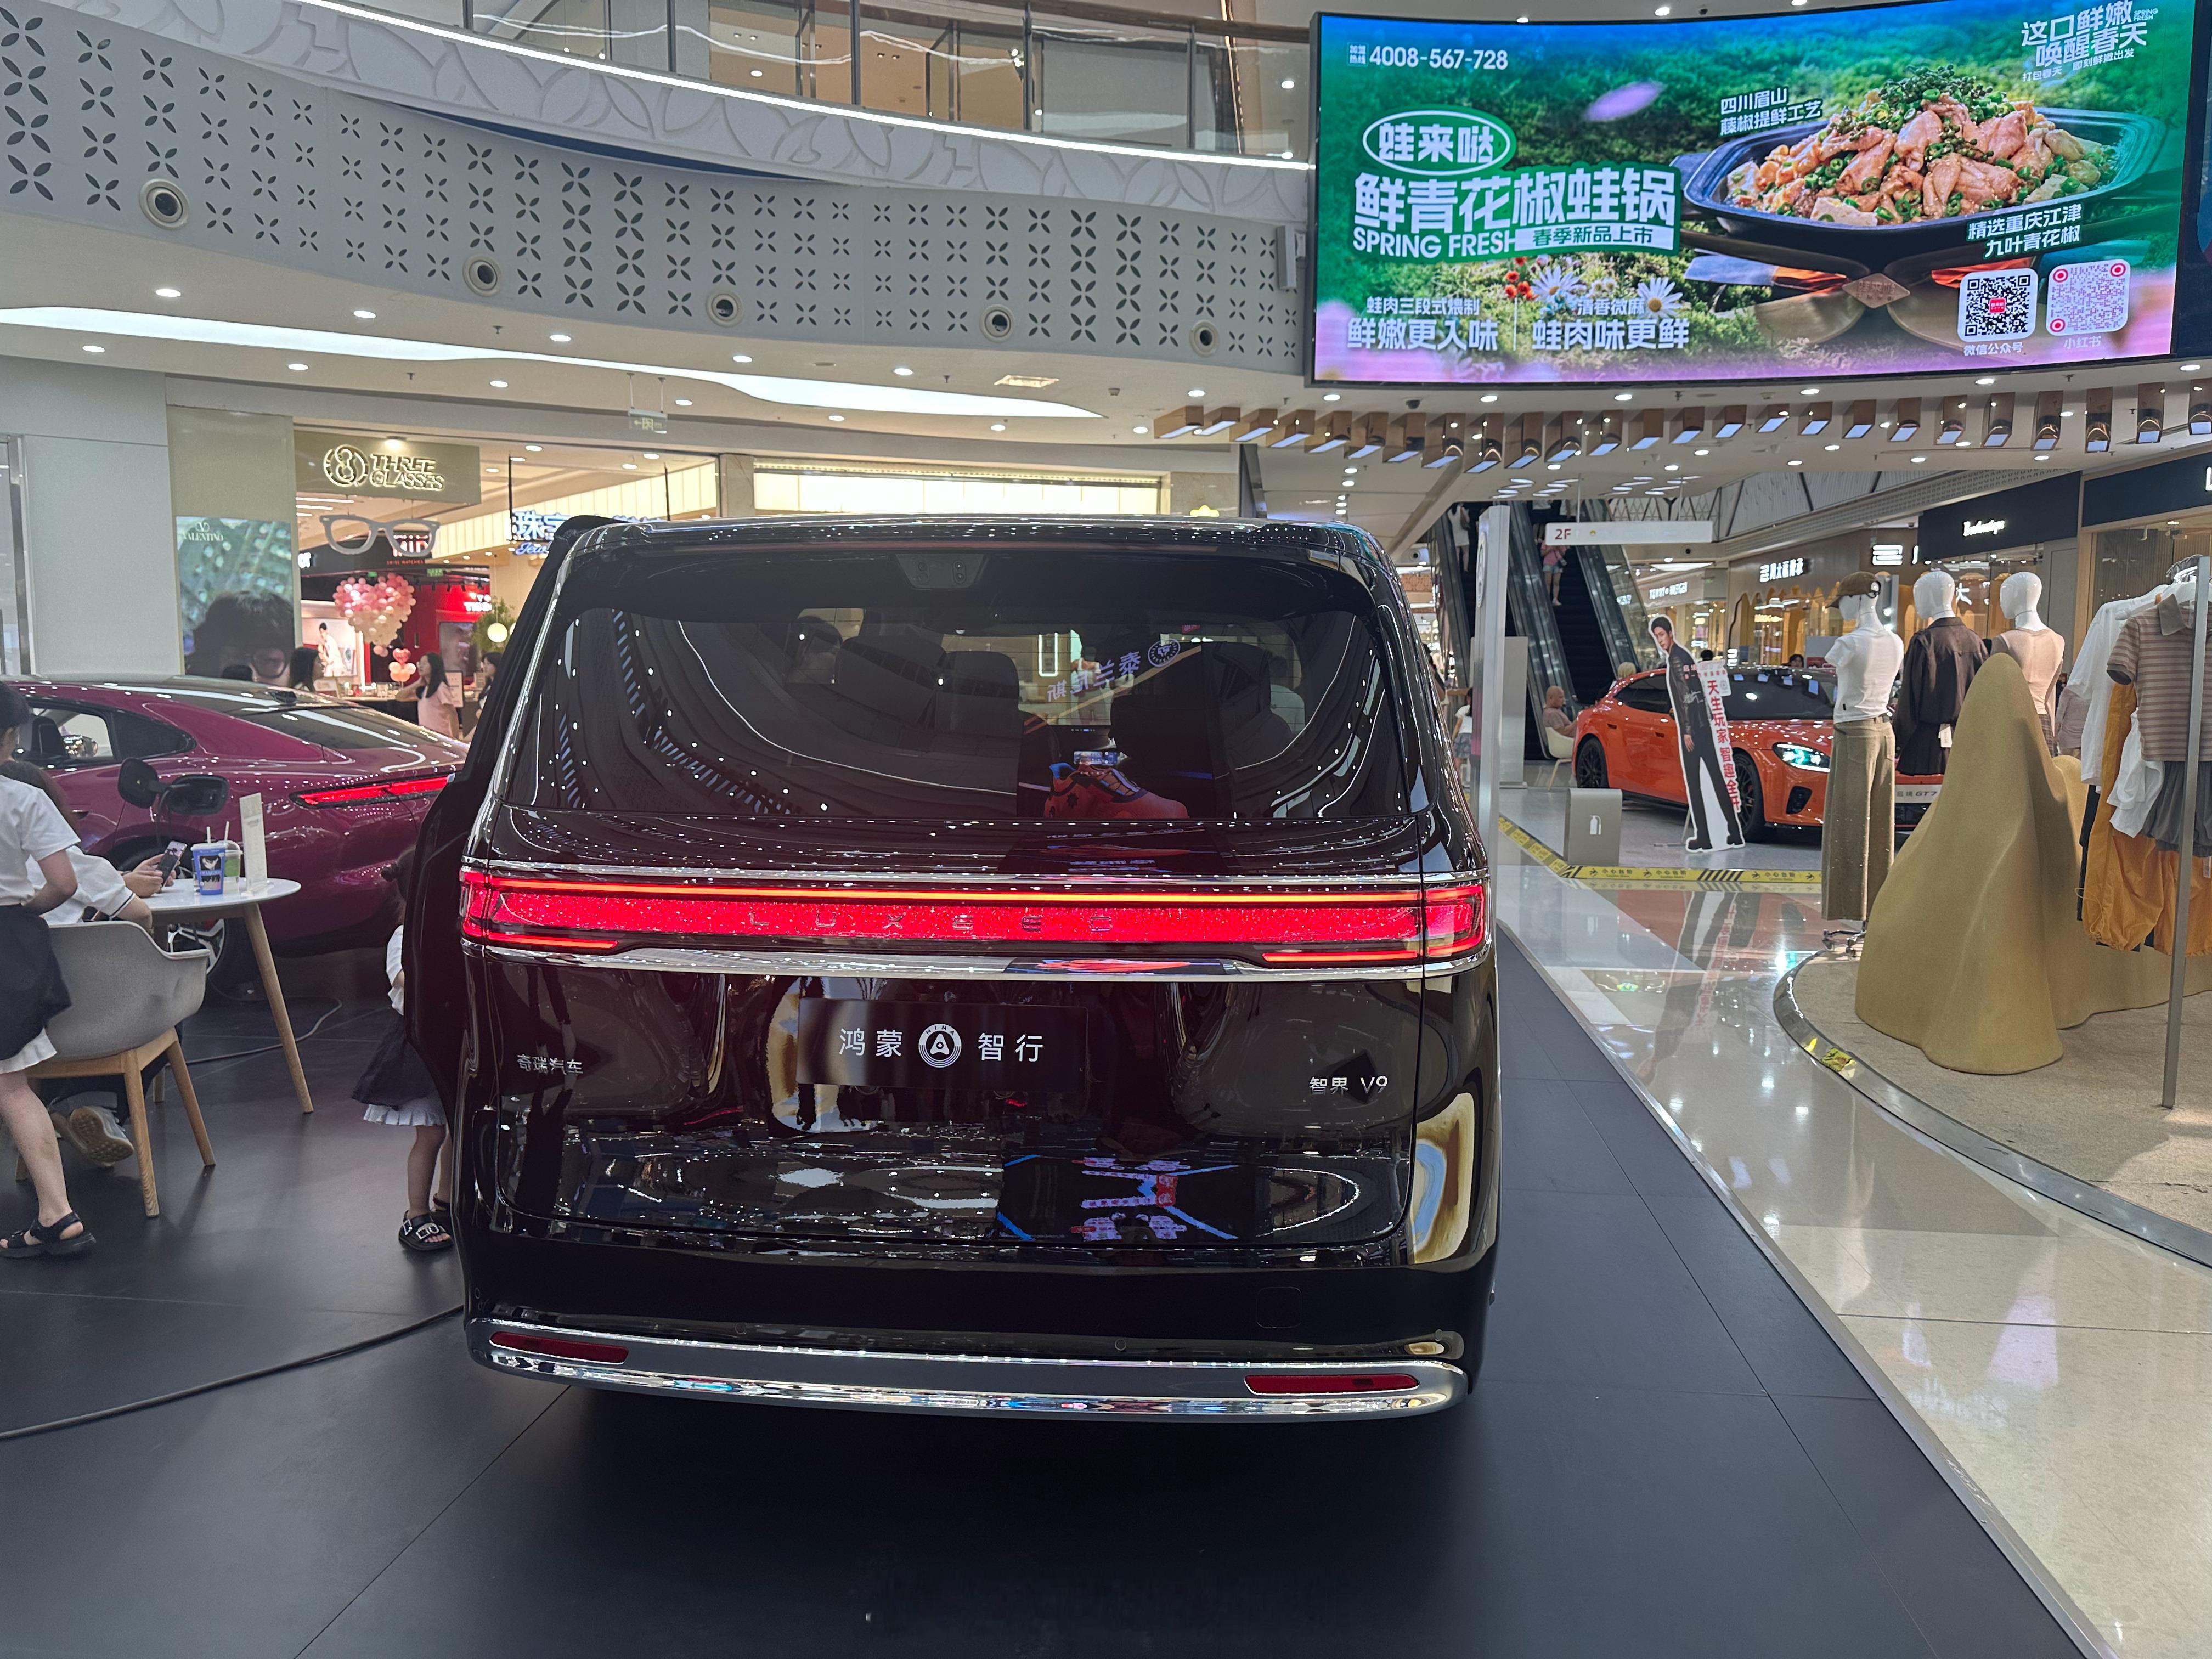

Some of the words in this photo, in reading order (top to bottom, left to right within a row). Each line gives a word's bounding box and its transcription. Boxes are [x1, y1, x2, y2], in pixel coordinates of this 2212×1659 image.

[2021, 1, 2133, 47] 这口鲜嫩
[1369, 46, 1508, 70] 4008-567-728
[2036, 22, 2147, 67] 唤醒春天
[1720, 87, 1787, 115] 四川眉山
[1720, 100, 1821, 136] 藤椒提鲜工艺
[1379, 122, 1494, 163] 蛙来哒
[1354, 167, 1677, 234] 鲜青花椒蛙锅
[1533, 221, 1653, 246] 春季新品上市
[1967, 204, 2082, 240] 精选重庆江津
[1352, 229, 1442, 258] SPRING
[1448, 233, 1516, 257] FRESH
[1984, 225, 2080, 258] 九叶青花椒
[1366, 296, 1480, 316] 蛙肉三段式煨制
[1347, 317, 1498, 351] 鲜嫩更入味
[1531, 317, 1690, 351] 蛙肉味更鲜
[2063, 335, 2102, 349] 小红书
[1963, 342, 2024, 356] 微信公众号
[369, 452, 437, 473] THREE
[369, 470, 444, 492] GLASSES
[183, 532, 224, 541] VALENTINO
[1555, 528, 1572, 540] 2F
[1707, 679, 1729, 744] 天生玩家
[839, 1028, 903, 1057] 鸿蒙
[925, 1025, 955, 1036] HIMA
[978, 1033, 1043, 1062] 智行
[1310, 1077, 1348, 1096] 智界
[1360, 1075, 1388, 1094] V9
